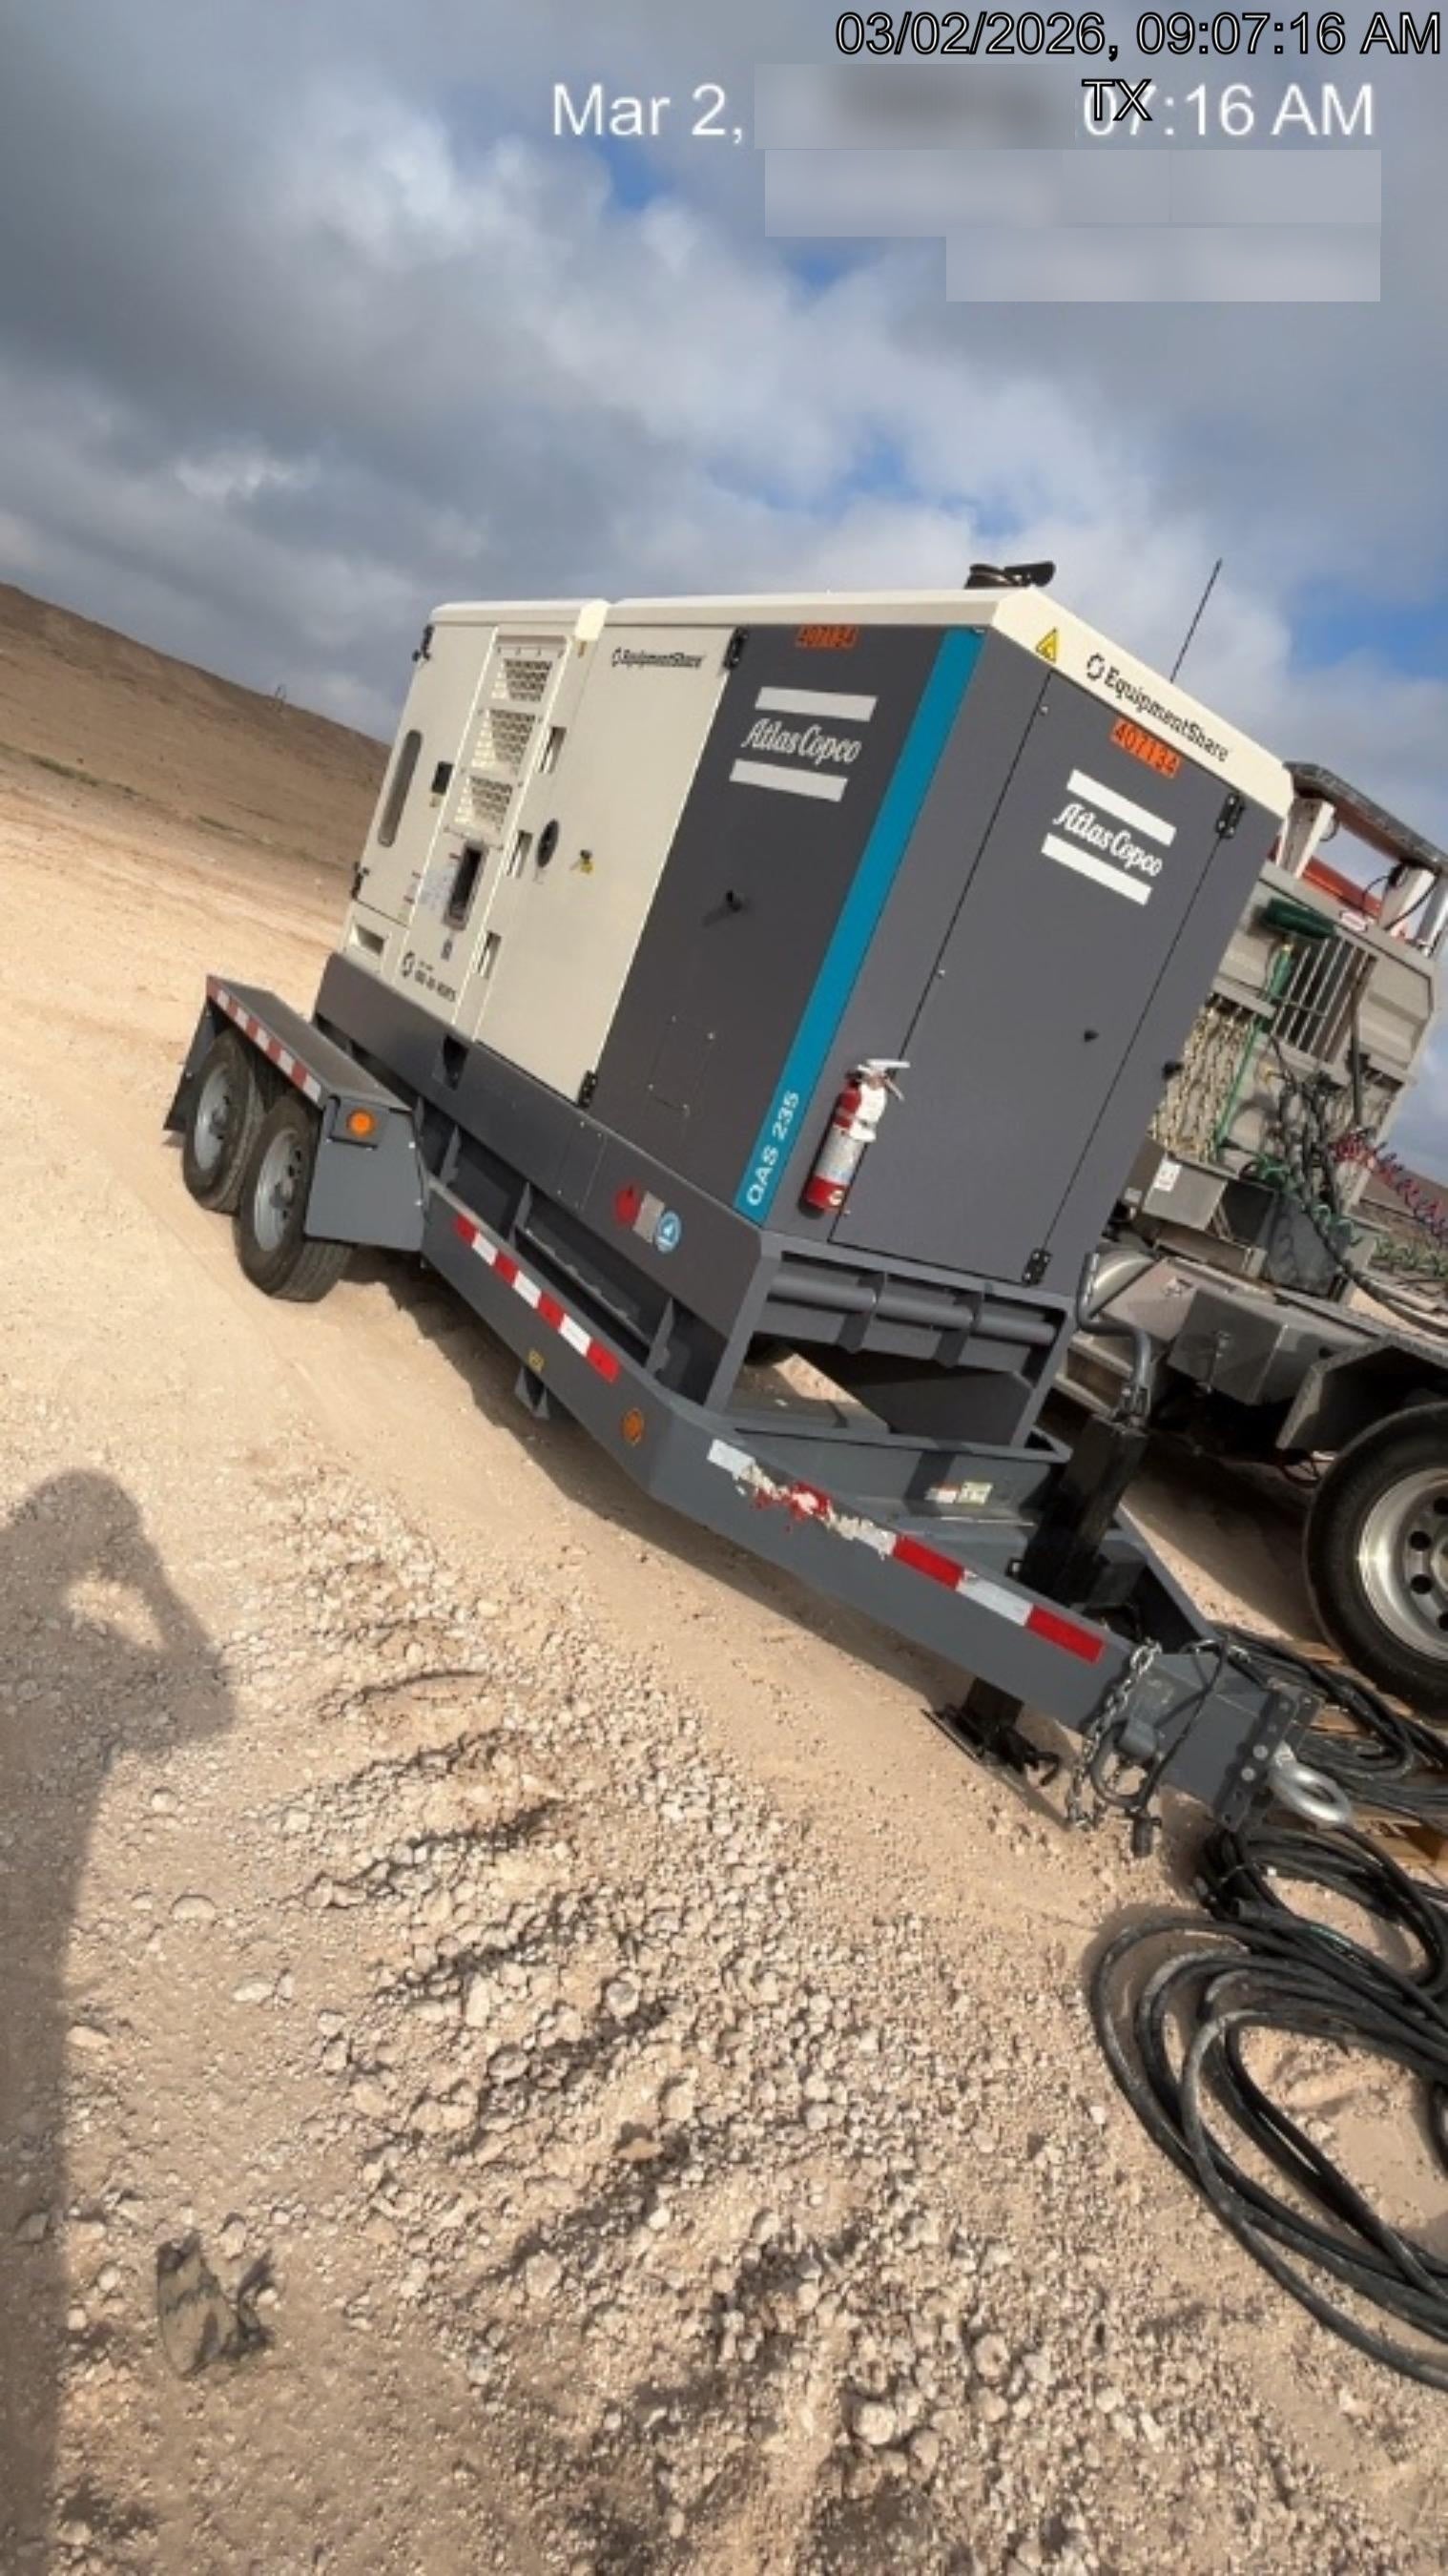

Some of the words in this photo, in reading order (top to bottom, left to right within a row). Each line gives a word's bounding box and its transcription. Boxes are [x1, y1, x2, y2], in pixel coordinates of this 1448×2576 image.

[1105, 666, 1229, 762] EquipmentShare
[746, 1145, 779, 1206] QAS
[772, 1091, 799, 1140] 235
